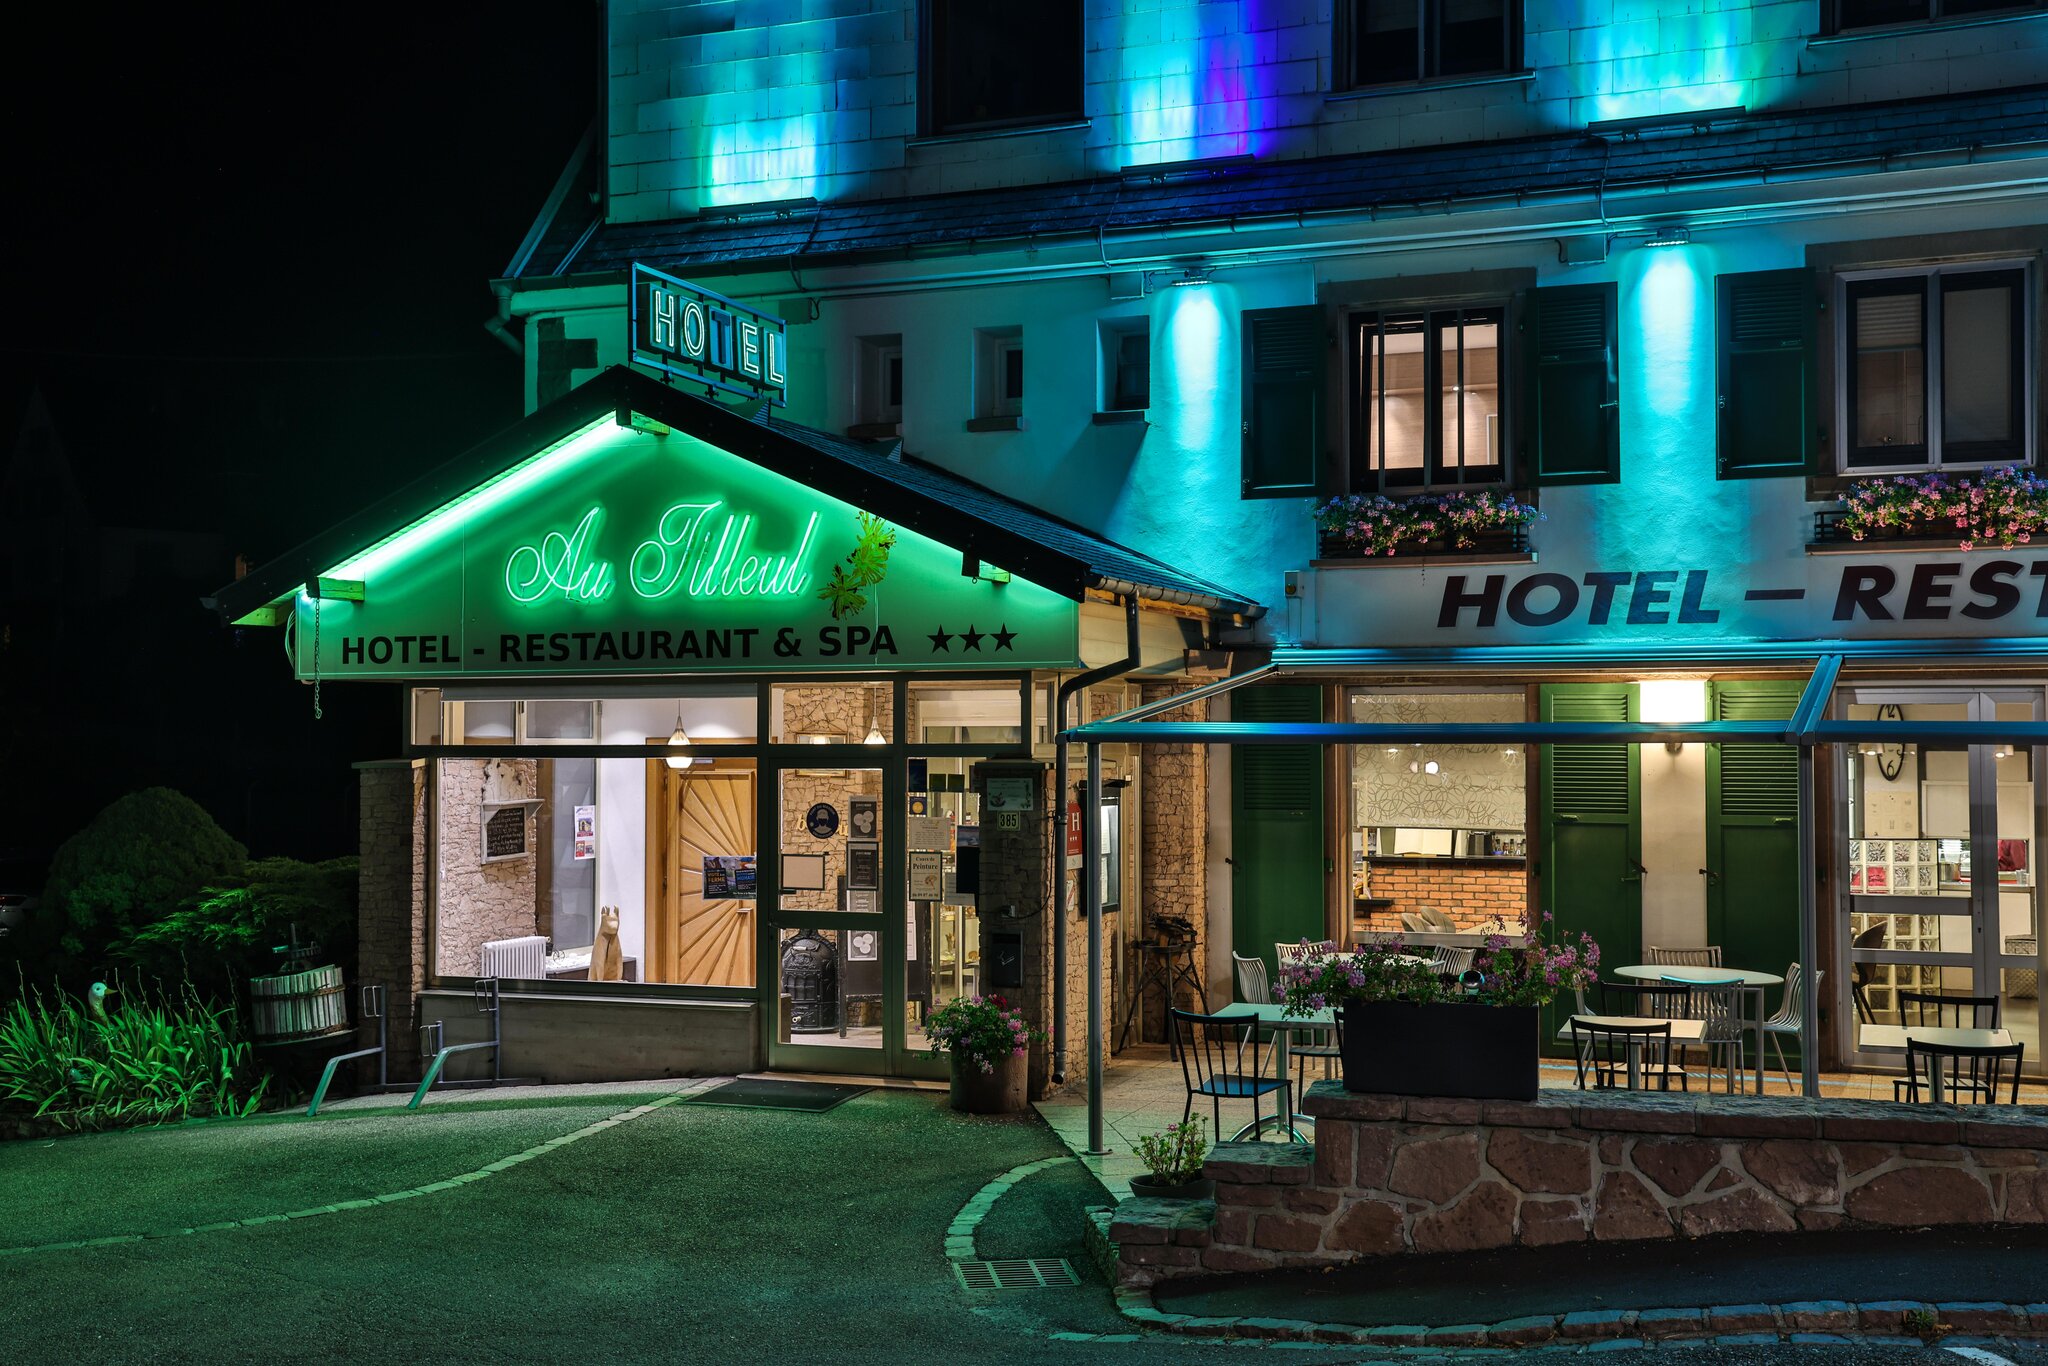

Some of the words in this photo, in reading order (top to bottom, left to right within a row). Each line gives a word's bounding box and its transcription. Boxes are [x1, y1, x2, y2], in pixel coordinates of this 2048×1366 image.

[655, 290, 784, 384] HOTEL
[505, 506, 614, 602] Au
[629, 500, 817, 598] Tilleul
[1437, 570, 1720, 627] HOTEL
[342, 635, 460, 664] HOTEL
[500, 628, 759, 662] RESTAURANT
[773, 627, 802, 657] &
[819, 625, 898, 656] SPA
[1000, 814, 1017, 827] 385
[1071, 812, 1080, 832] H
